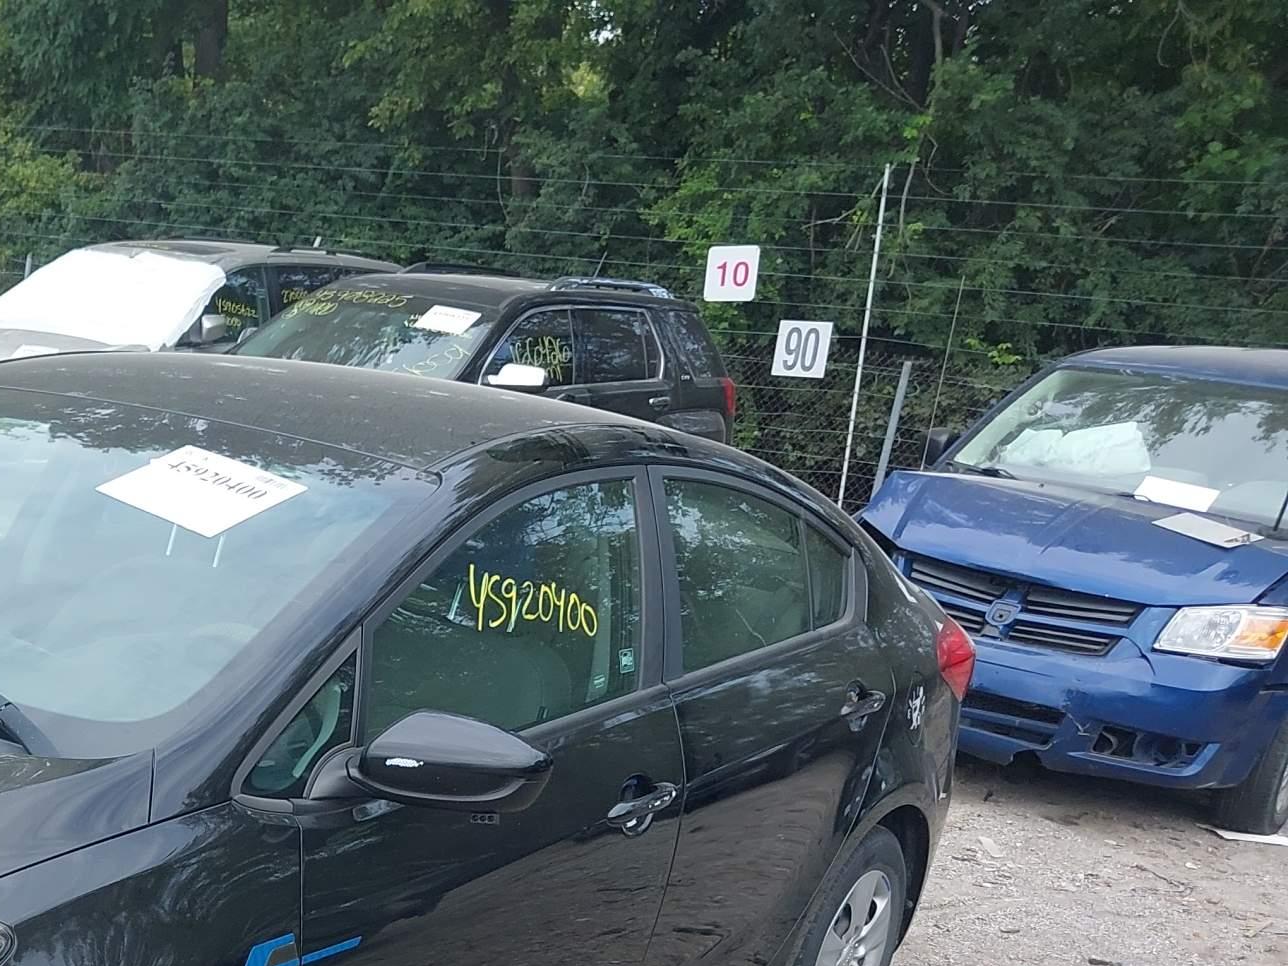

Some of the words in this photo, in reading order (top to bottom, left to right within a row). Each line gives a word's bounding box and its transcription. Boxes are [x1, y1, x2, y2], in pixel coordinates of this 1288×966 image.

[716, 261, 750, 287] 10
[782, 327, 820, 372] 90
[469, 564, 598, 637] 45920400
